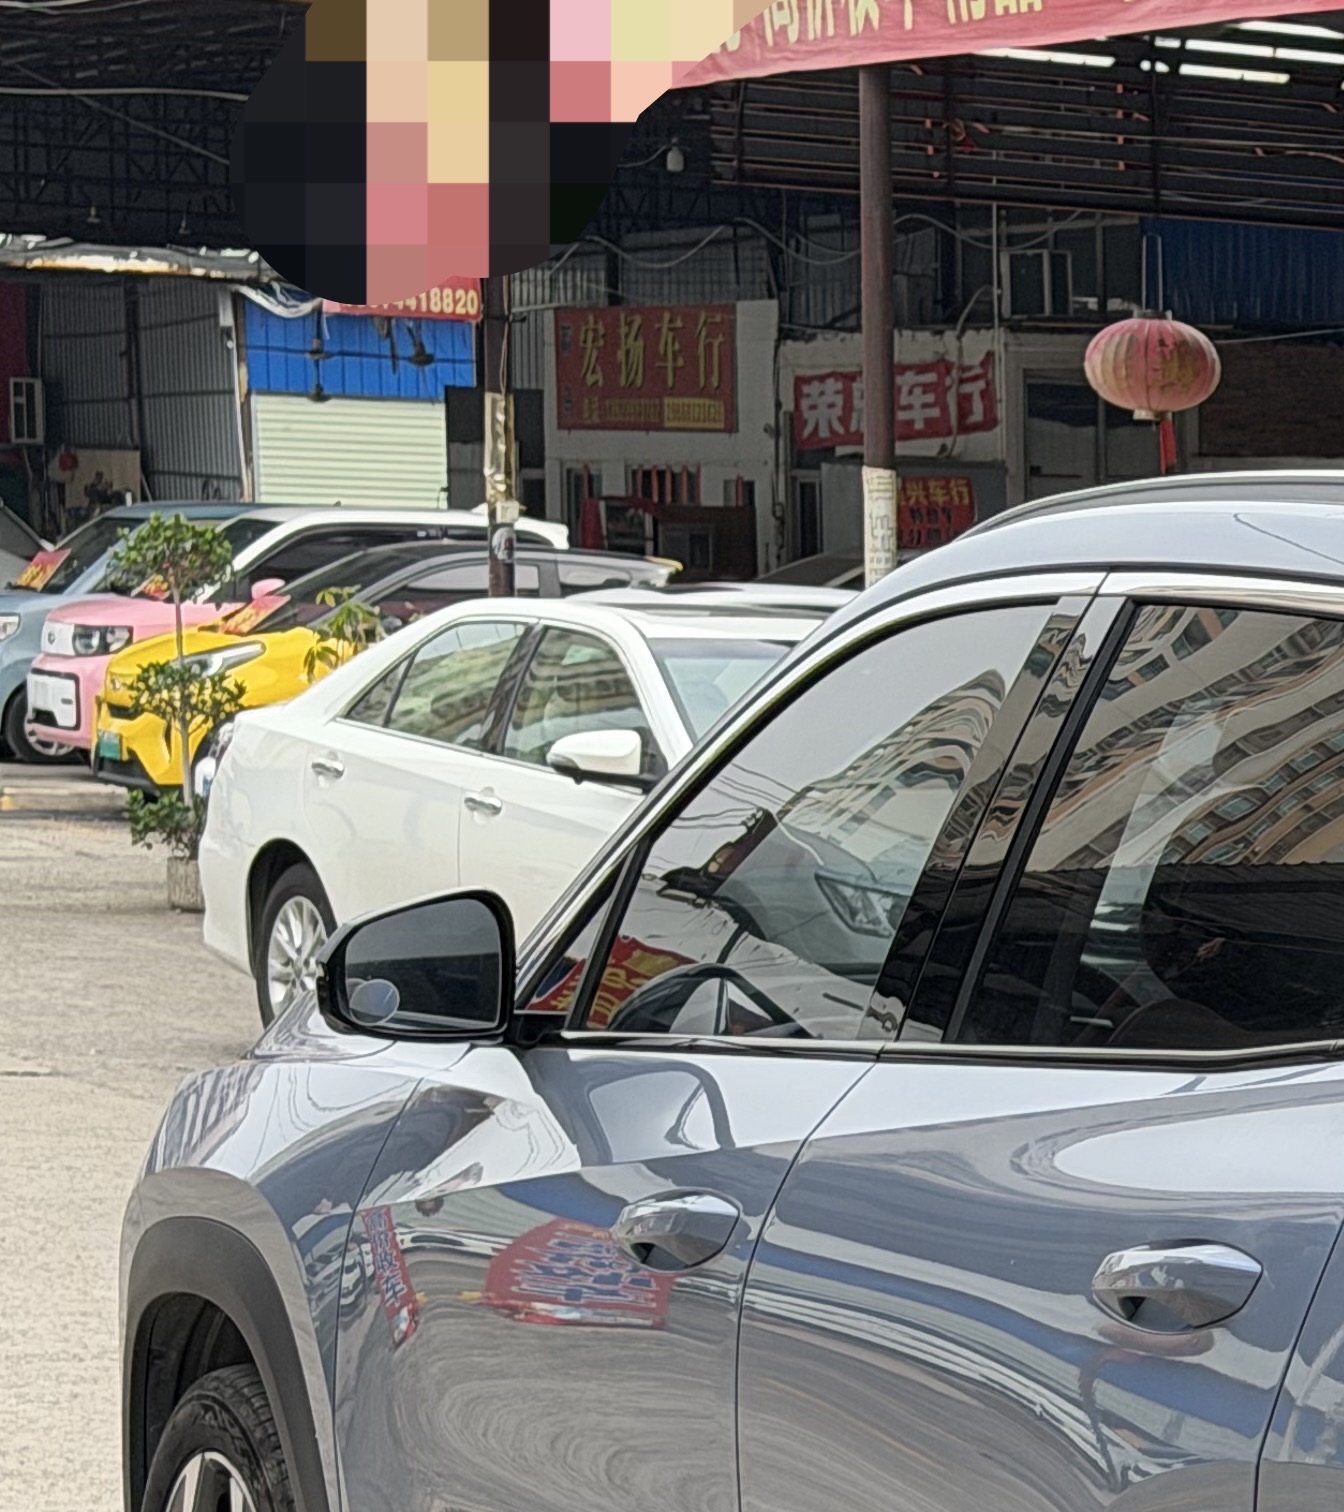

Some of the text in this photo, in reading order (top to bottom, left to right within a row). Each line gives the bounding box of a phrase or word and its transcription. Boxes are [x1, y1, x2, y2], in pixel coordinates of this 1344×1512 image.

[579, 310, 726, 390] 宏扬车行
[800, 366, 988, 440] 荣车行
